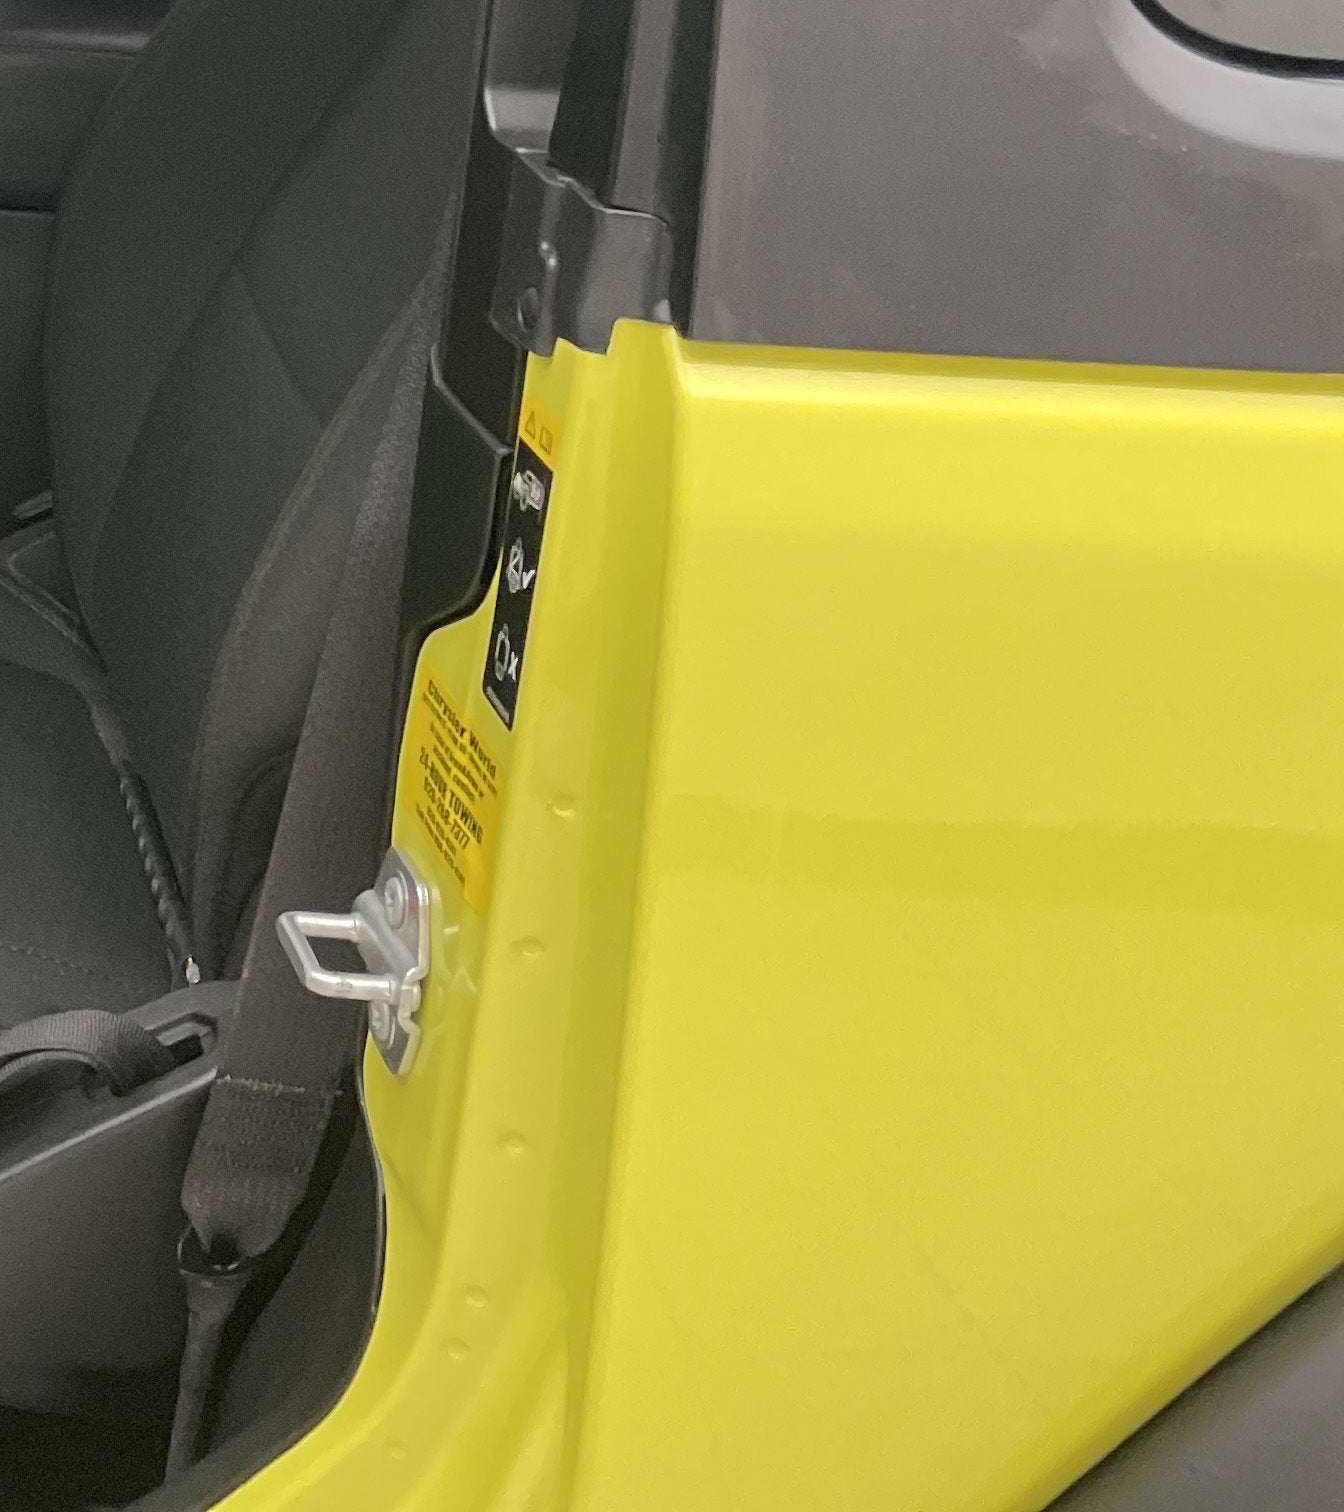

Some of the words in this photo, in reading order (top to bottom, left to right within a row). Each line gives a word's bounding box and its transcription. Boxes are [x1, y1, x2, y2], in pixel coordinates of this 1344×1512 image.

[428, 679, 467, 738] Chrysler
[469, 729, 497, 781] World
[449, 789, 483, 845] TOWING
